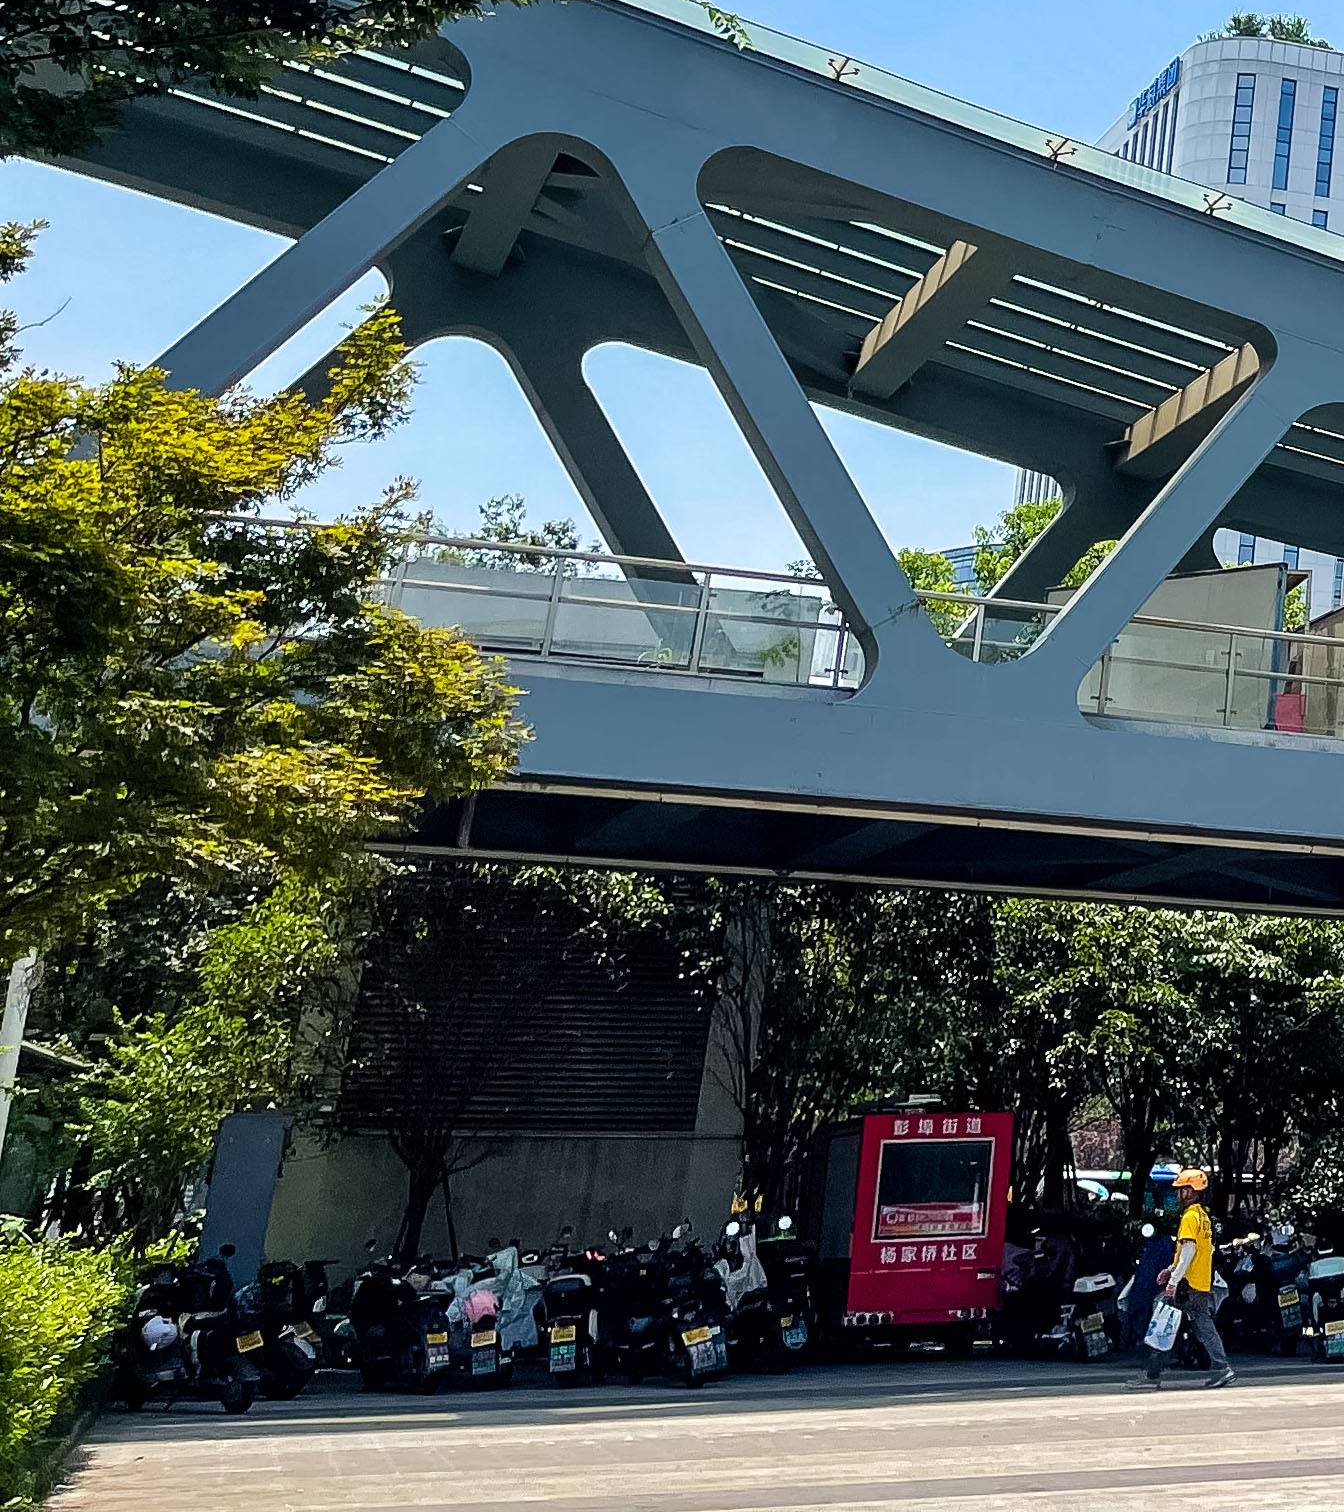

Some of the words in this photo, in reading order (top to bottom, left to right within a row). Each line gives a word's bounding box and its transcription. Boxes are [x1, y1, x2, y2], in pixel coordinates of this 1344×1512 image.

[893, 1117, 982, 1136] 彭埠街道
[880, 1244, 978, 1264] 杨家桥社区
